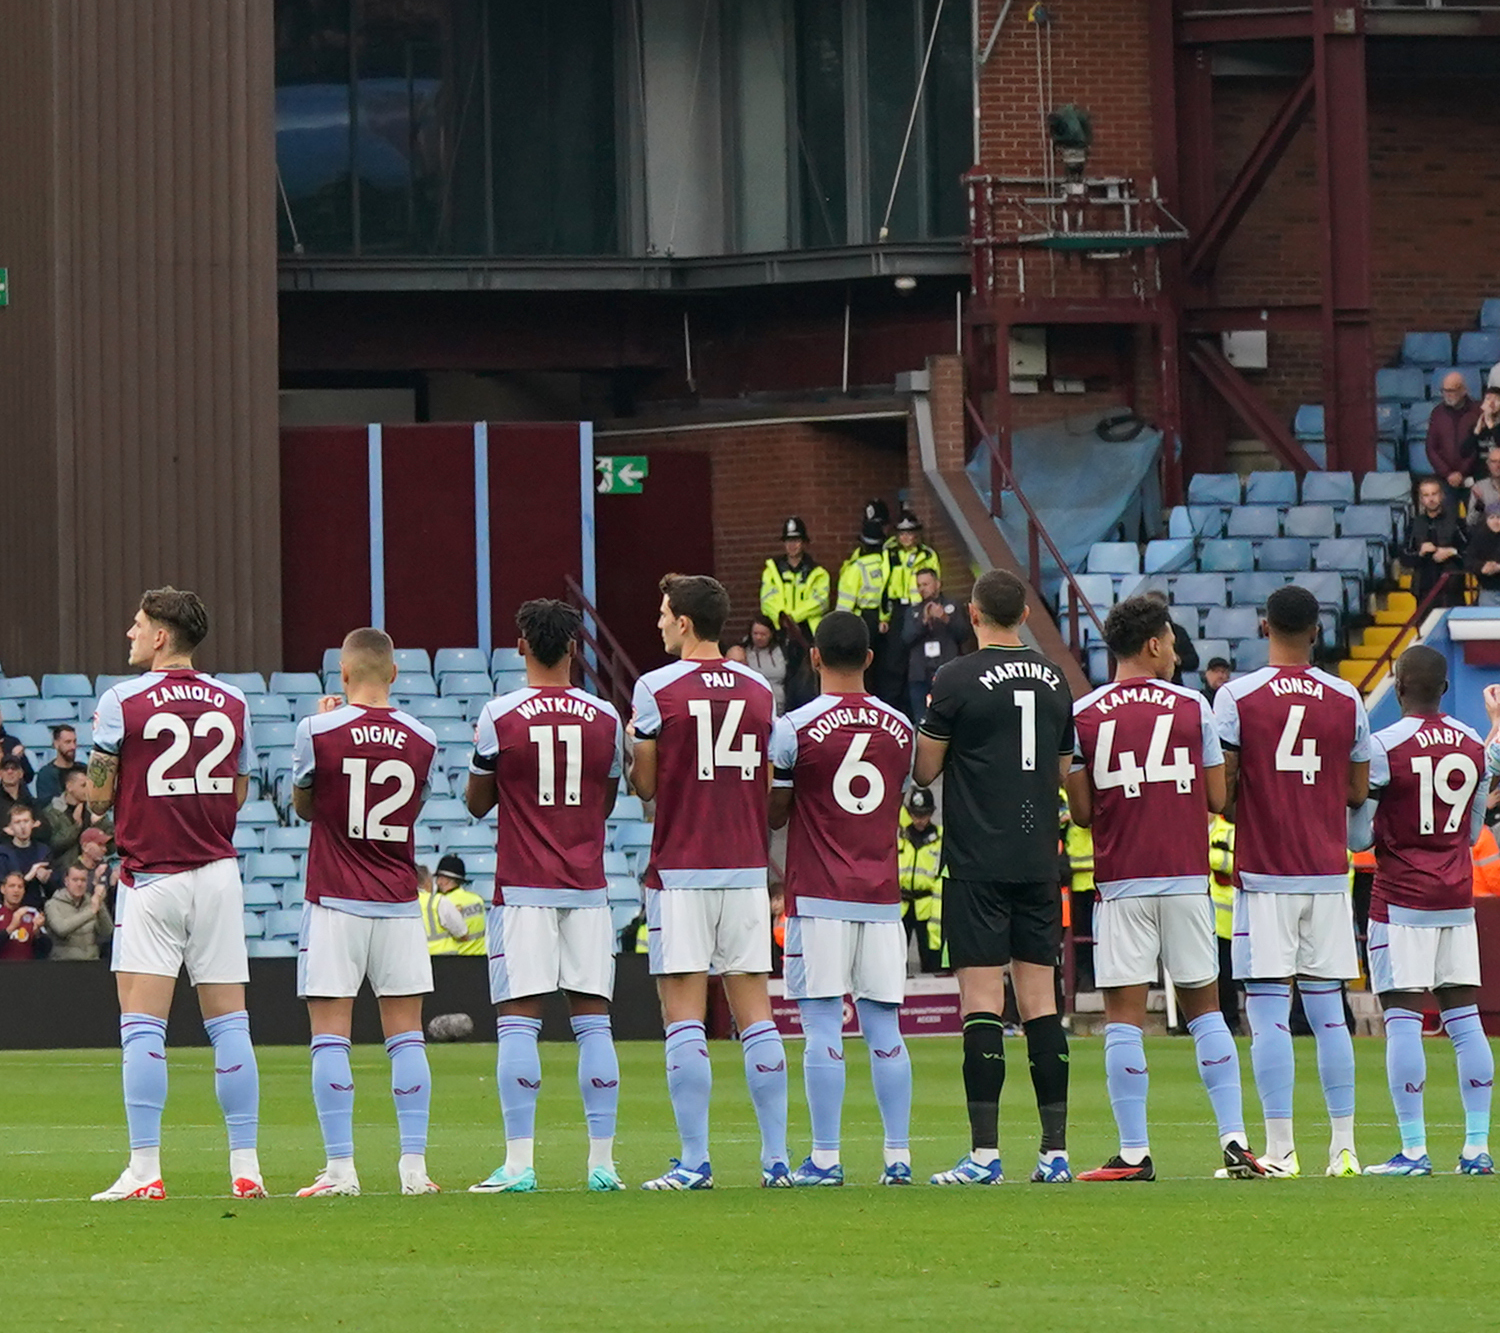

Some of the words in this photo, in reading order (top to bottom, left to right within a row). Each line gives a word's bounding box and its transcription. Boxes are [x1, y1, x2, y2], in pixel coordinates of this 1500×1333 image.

[147, 685, 226, 708] ZANIOLO
[701, 672, 736, 688] PAU
[979, 662, 1061, 691] MARTINEZ
[1096, 688, 1176, 714] KAMARA
[1269, 678, 1323, 700] KONSA
[350, 725, 408, 749] DIGNE
[516, 697, 598, 723] WATKINS
[688, 699, 761, 780] 14
[808, 708, 879, 744] DOUGLAS
[880, 712, 911, 750] LUIZ
[1014, 690, 1036, 771] 1
[1415, 728, 1465, 748] DIABY
[143, 711, 236, 797] 22
[529, 725, 582, 806] 11
[833, 733, 885, 815] 6
[1093, 713, 1196, 799] 44
[1275, 704, 1321, 785] 4
[342, 757, 416, 843] 12
[1411, 752, 1479, 835] 19
